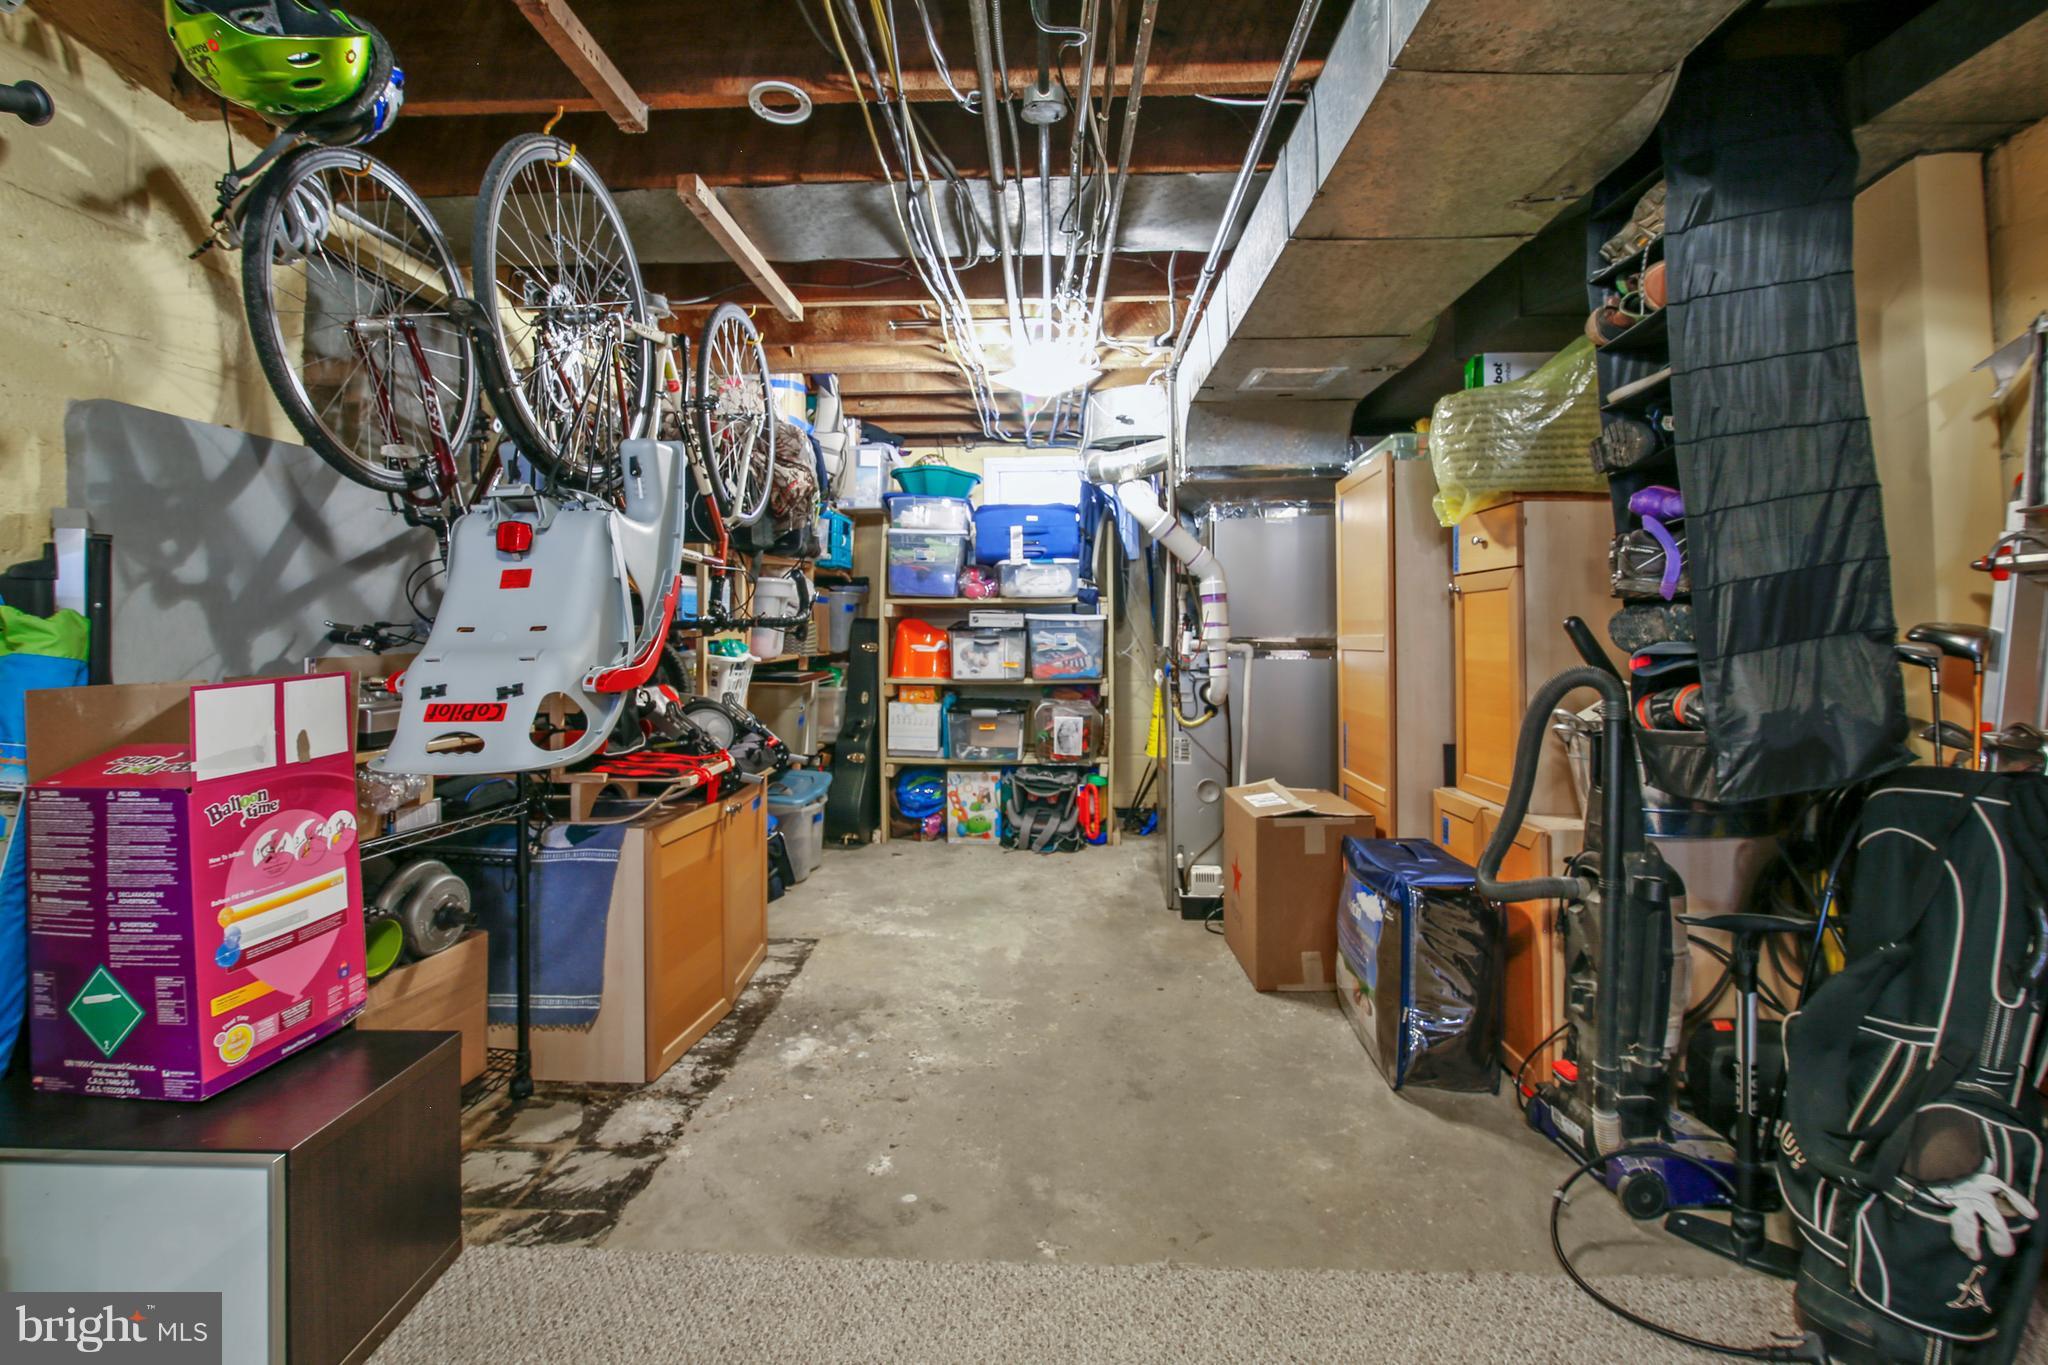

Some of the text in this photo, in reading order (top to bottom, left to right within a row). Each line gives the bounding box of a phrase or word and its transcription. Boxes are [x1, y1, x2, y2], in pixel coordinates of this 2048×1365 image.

[420, 379, 446, 437] RST
[428, 703, 503, 721] CoPilot
[205, 789, 268, 826] Balloon
[245, 799, 279, 820] time
[103, 1039, 110, 1050] 2
